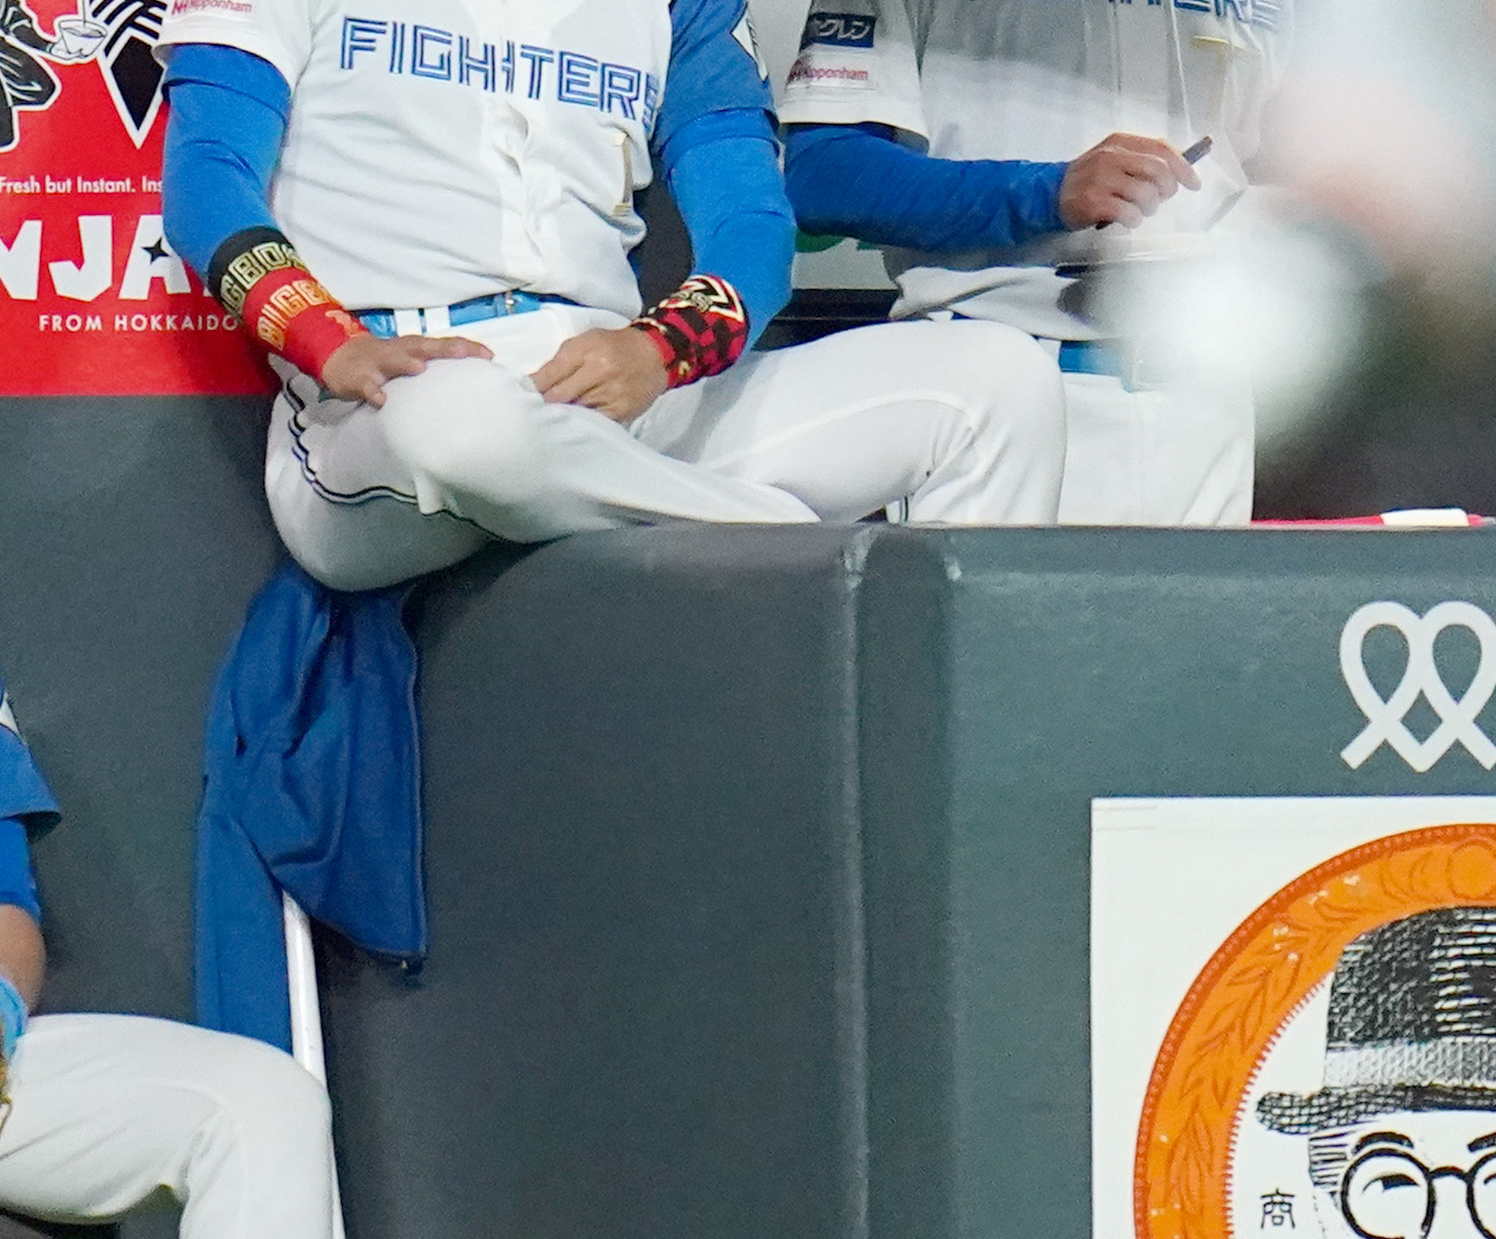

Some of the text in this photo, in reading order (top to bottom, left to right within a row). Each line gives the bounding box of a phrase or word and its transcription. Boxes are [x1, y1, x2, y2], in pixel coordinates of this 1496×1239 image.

[0, 175, 41, 194] Fresh
[45, 175, 72, 194] but
[77, 175, 136, 194] Instant.
[38, 314, 239, 332] FROM HOKKAIDO
[1259, 1188, 1296, 1230] 商
